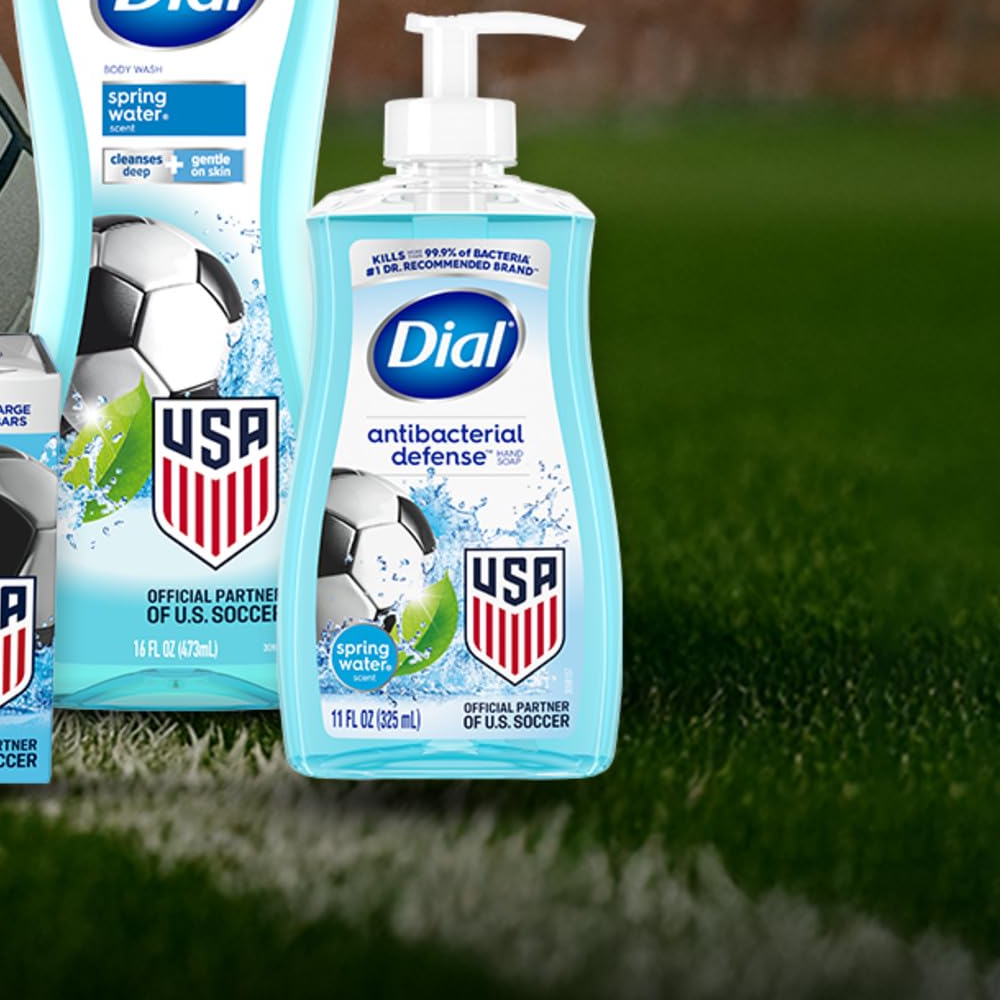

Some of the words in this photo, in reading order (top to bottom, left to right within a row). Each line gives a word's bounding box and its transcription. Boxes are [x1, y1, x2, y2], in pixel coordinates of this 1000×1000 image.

[104, 65, 131, 74] BODY
[133, 65, 163, 74] WASH
[108, 88, 167, 108] spring
[109, 124, 136, 133] scent
[110, 153, 163, 165] cleanses
[191, 153, 231, 167] gentle
[122, 167, 151, 178] deep
[191, 168, 206, 177] on
[208, 167, 232, 177] skin
[372, 250, 406, 265] KILLS
[424, 247, 457, 258] 99.9%
[458, 248, 472, 258] of
[383, 263, 403, 274] DR.
[403, 259, 491, 272] RECOMMENDED
[387, 320, 507, 368] Dial
[163, 408, 268, 470] USA
[367, 424, 524, 443] antibacterial
[391, 446, 487, 466] defense
[496, 449, 524, 457] HAND
[496, 457, 522, 466] SOAP
[473, 557, 557, 606] USA
[147, 589, 212, 603] OFFICIAL
[147, 605, 171, 624] OF
[175, 605, 208, 624] U.S.
[134, 640, 146, 658] 16
[148, 640, 160, 658] FL
[162, 640, 175, 658] OZ
[336, 640, 389, 659] spring
[353, 674, 377, 682] scent
[463, 702, 514, 713] OFFICIAL
[516, 701, 570, 713] PARTNER
[331, 709, 343, 728] 11
[345, 709, 358, 728] FL
[360, 709, 374, 729] OZ
[376, 708, 398, 731] (325
[400, 708, 421, 731] mL)
[463, 715, 482, 729] OF
[485, 715, 512, 729] U.S.
[513, 714, 570, 729] SOCCER
